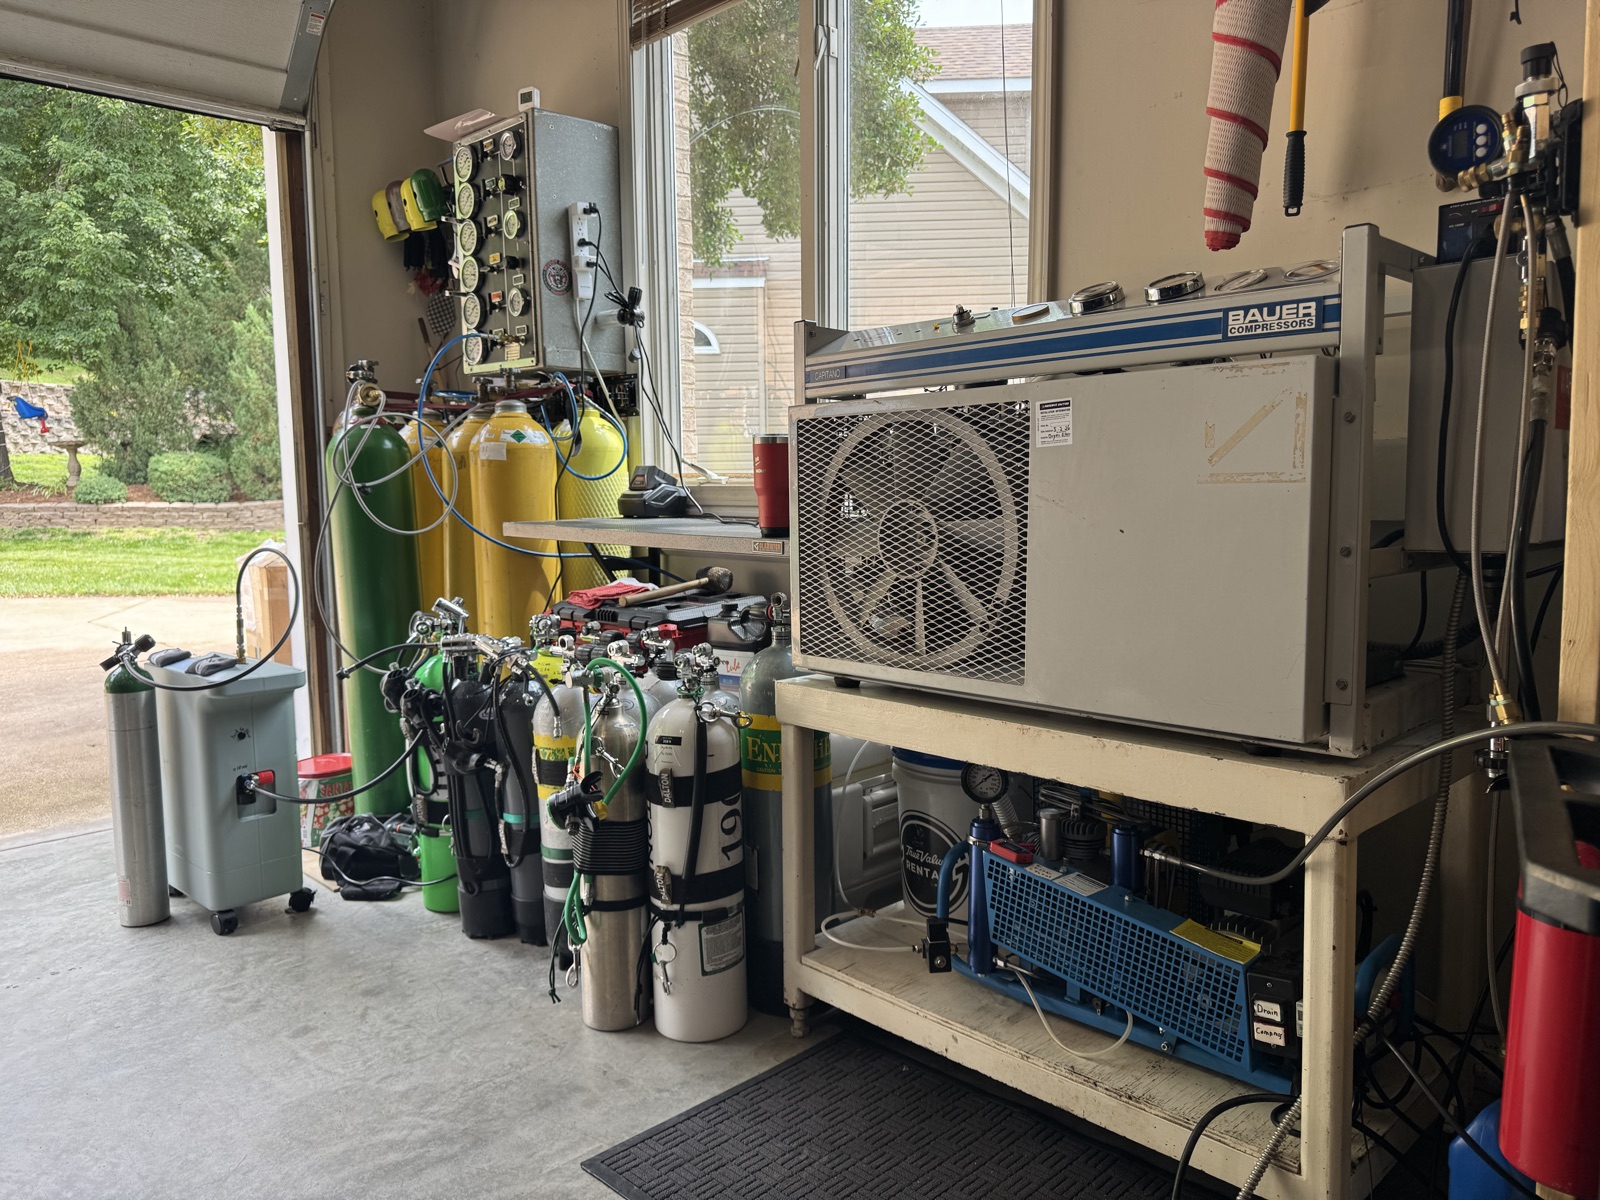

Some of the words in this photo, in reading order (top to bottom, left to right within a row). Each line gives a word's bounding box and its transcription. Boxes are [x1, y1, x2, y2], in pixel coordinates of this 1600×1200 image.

[1228, 302, 1317, 324] BAUER
[1229, 318, 1314, 335] COMPRESSORS
[814, 369, 841, 380] CAPITANO
[661, 773, 672, 804] DALTON
[906, 859, 940, 881] RENTA
[656, 872, 669, 901] DALTON
